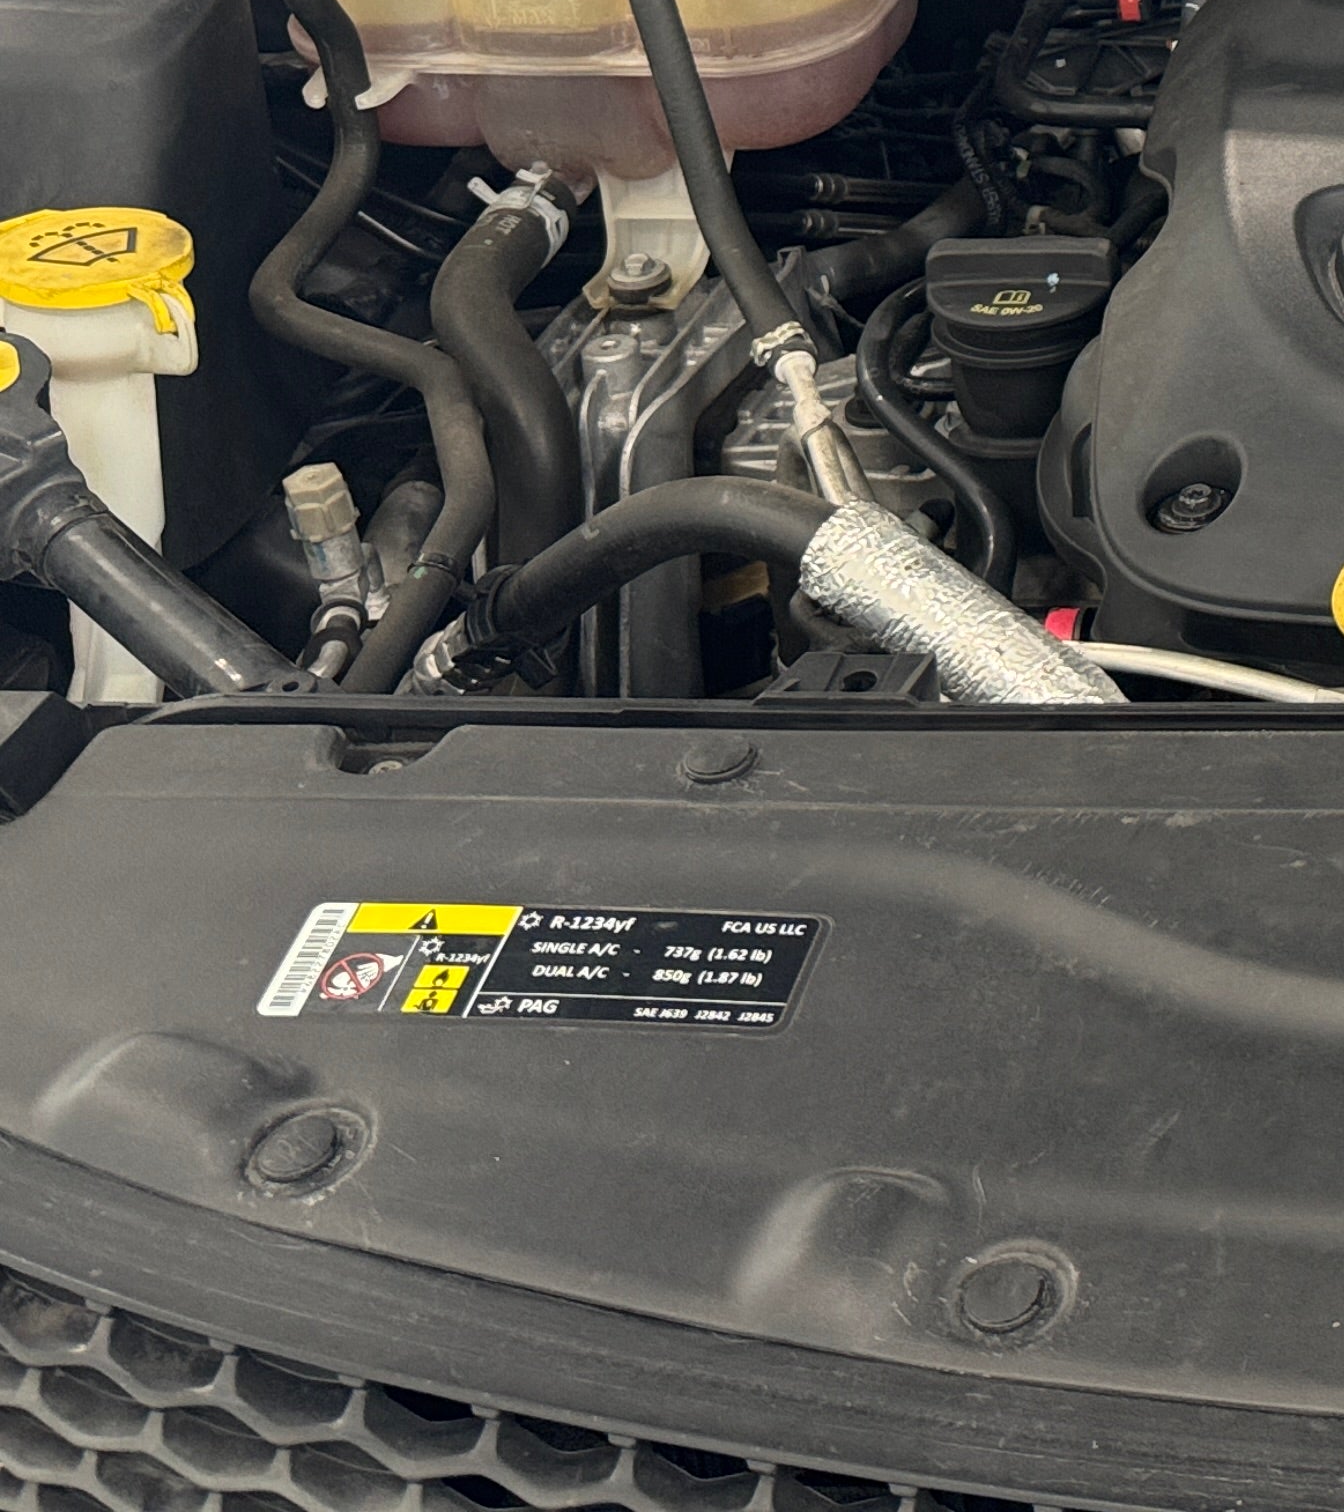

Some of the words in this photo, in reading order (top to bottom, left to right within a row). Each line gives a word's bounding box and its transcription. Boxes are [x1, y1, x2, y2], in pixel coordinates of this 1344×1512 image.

[969, 303, 999, 316] SAE
[1000, 303, 1044, 316] 0W-20
[550, 916, 636, 934] R-1234yf
[721, 921, 751, 934] FCA
[754, 923, 777, 935] US
[779, 923, 807, 936] LLC
[531, 941, 586, 955] SINGLE
[587, 943, 620, 956] A/C
[663, 946, 702, 961] 737g
[706, 947, 749, 962] (1.62
[750, 948, 773, 965] lb)
[531, 965, 575, 978] DUAL
[576, 966, 609, 980] A/C
[652, 969, 692, 985] 850g
[696, 970, 739, 986] (1.87
[740, 972, 763, 988] lb)
[517, 998, 560, 1014] PAG
[632, 1007, 658, 1018] SAE
